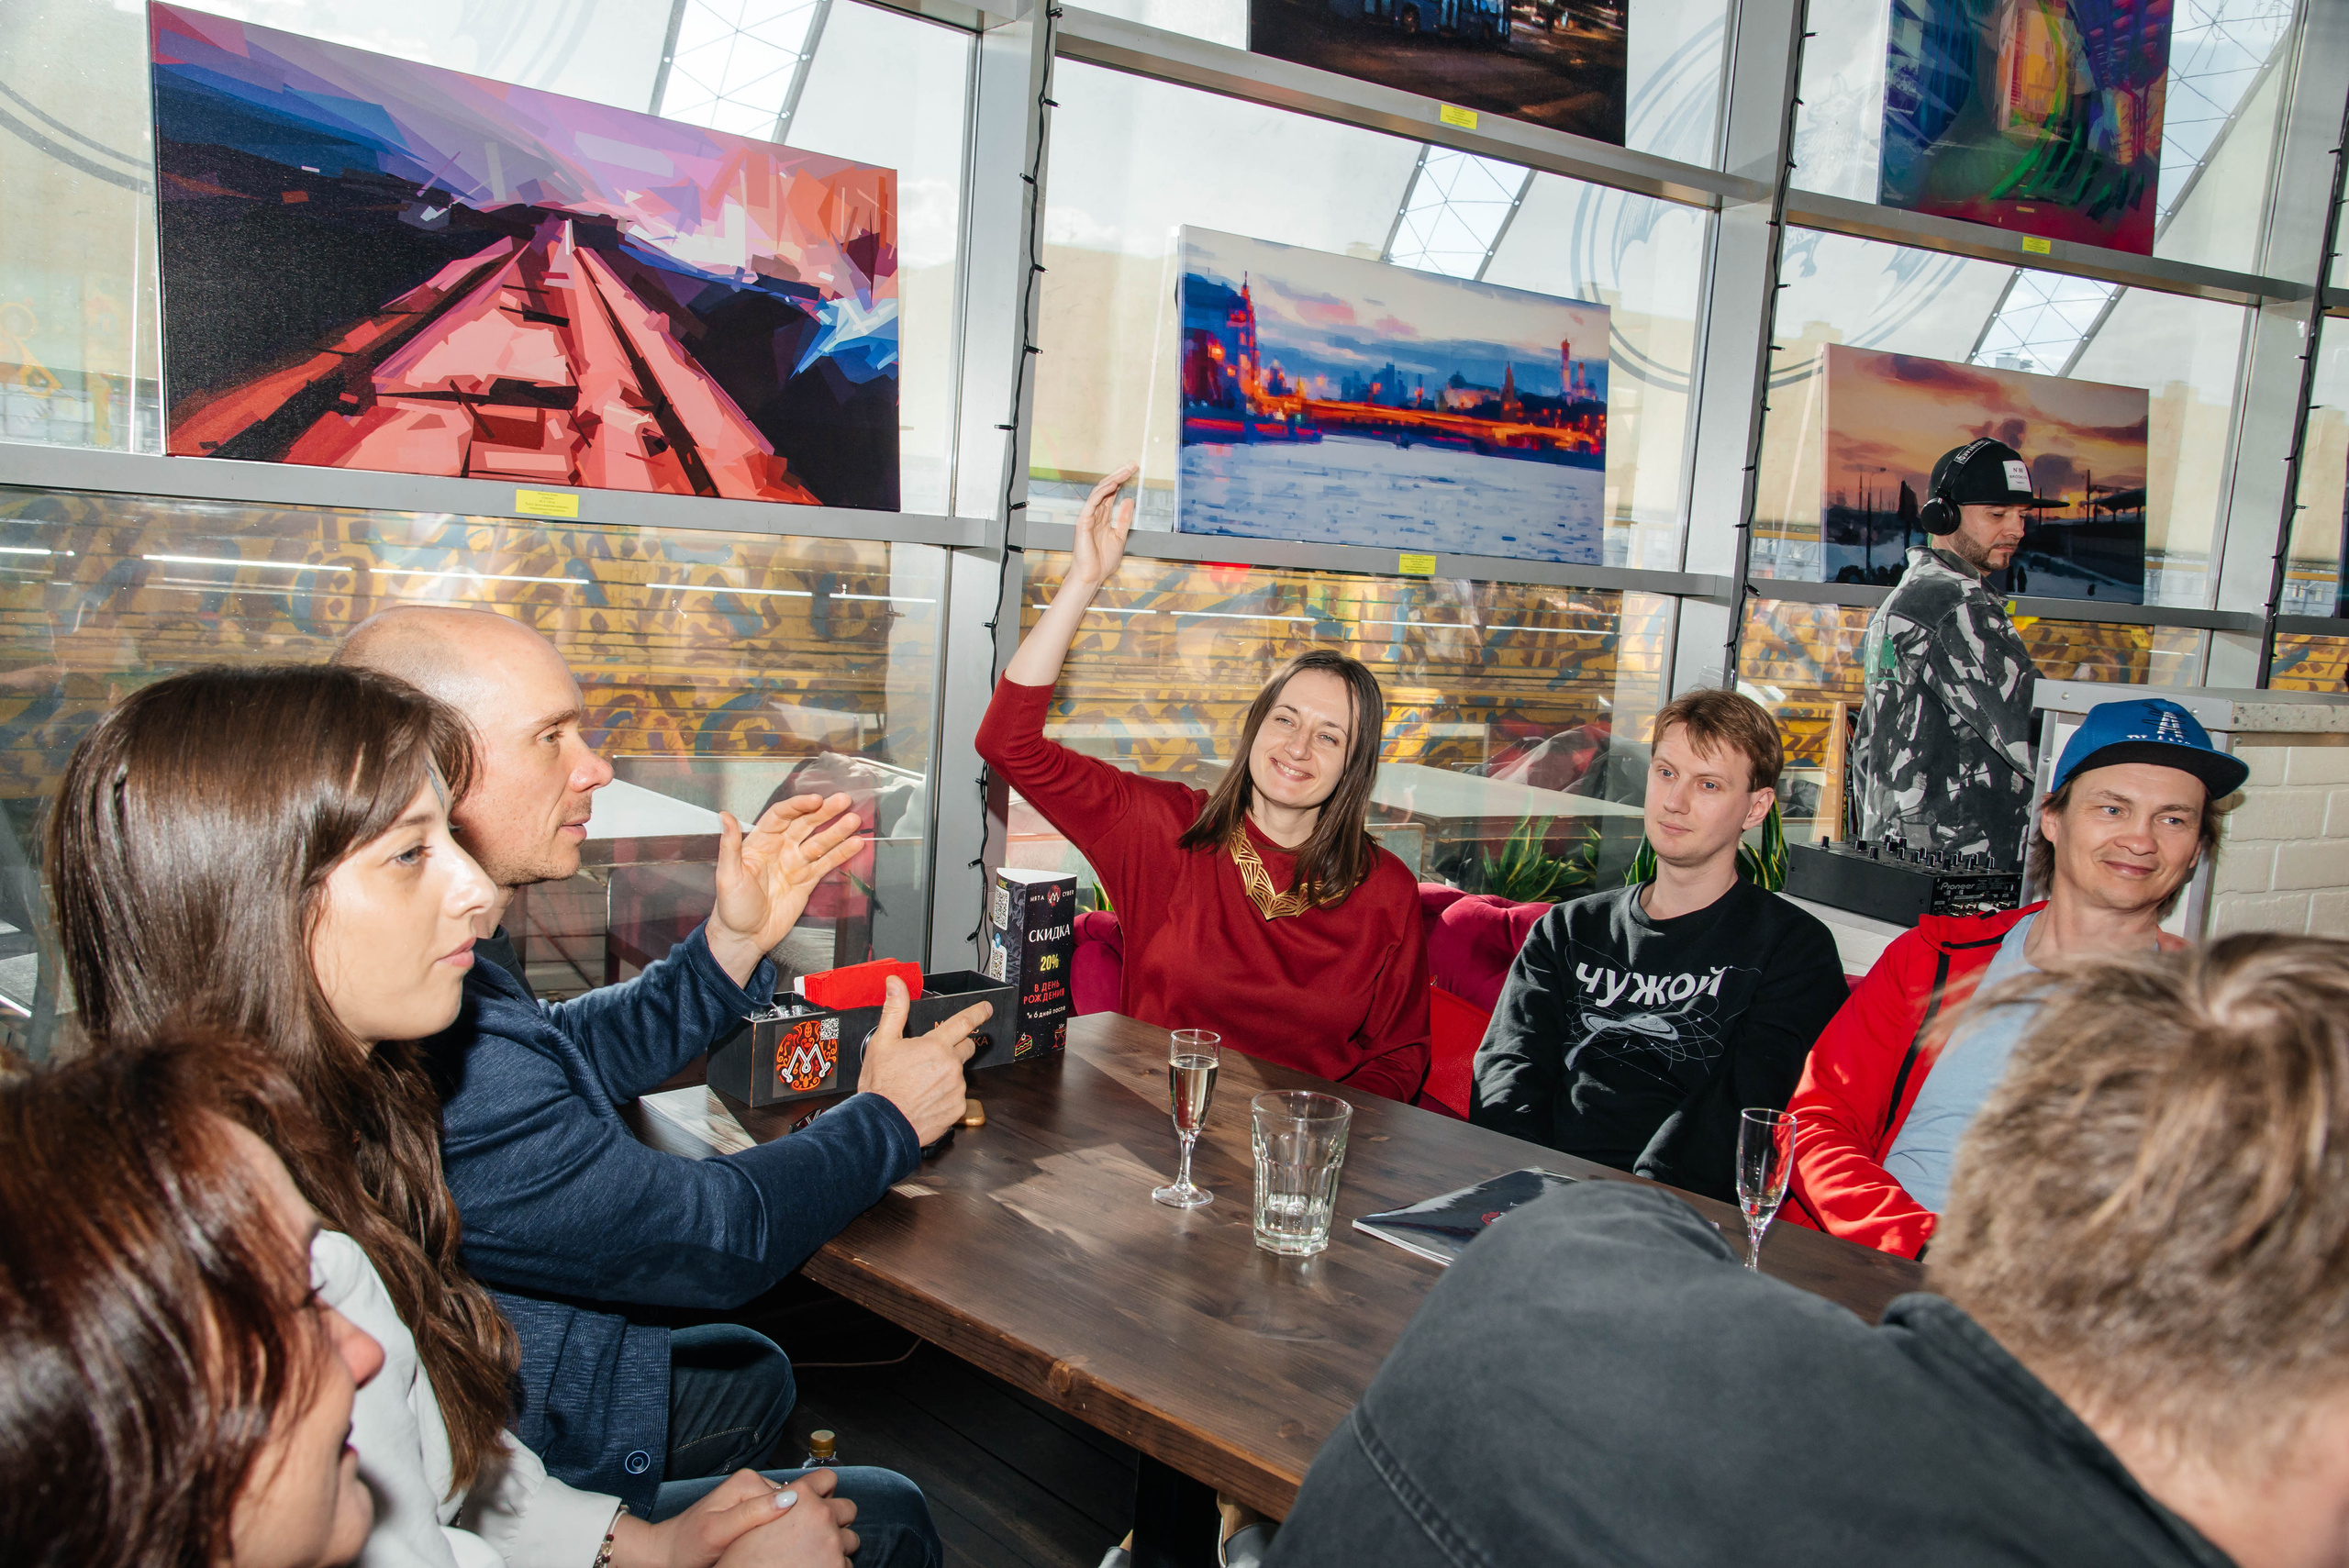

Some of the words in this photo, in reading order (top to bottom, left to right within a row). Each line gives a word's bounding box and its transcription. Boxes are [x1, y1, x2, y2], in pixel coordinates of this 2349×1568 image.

[1941, 882, 1975, 890] Pioneer
[1029, 924, 1071, 942] СКИДКА
[1040, 953, 1059, 972] 20%
[1034, 984, 1040, 993] В
[1041, 979, 1060, 993] ДЕНЬ
[1023, 987, 1064, 1005] РОЖДЕНИЯ
[1039, 1008, 1052, 1018] дней
[1052, 1006, 1066, 1015] после
